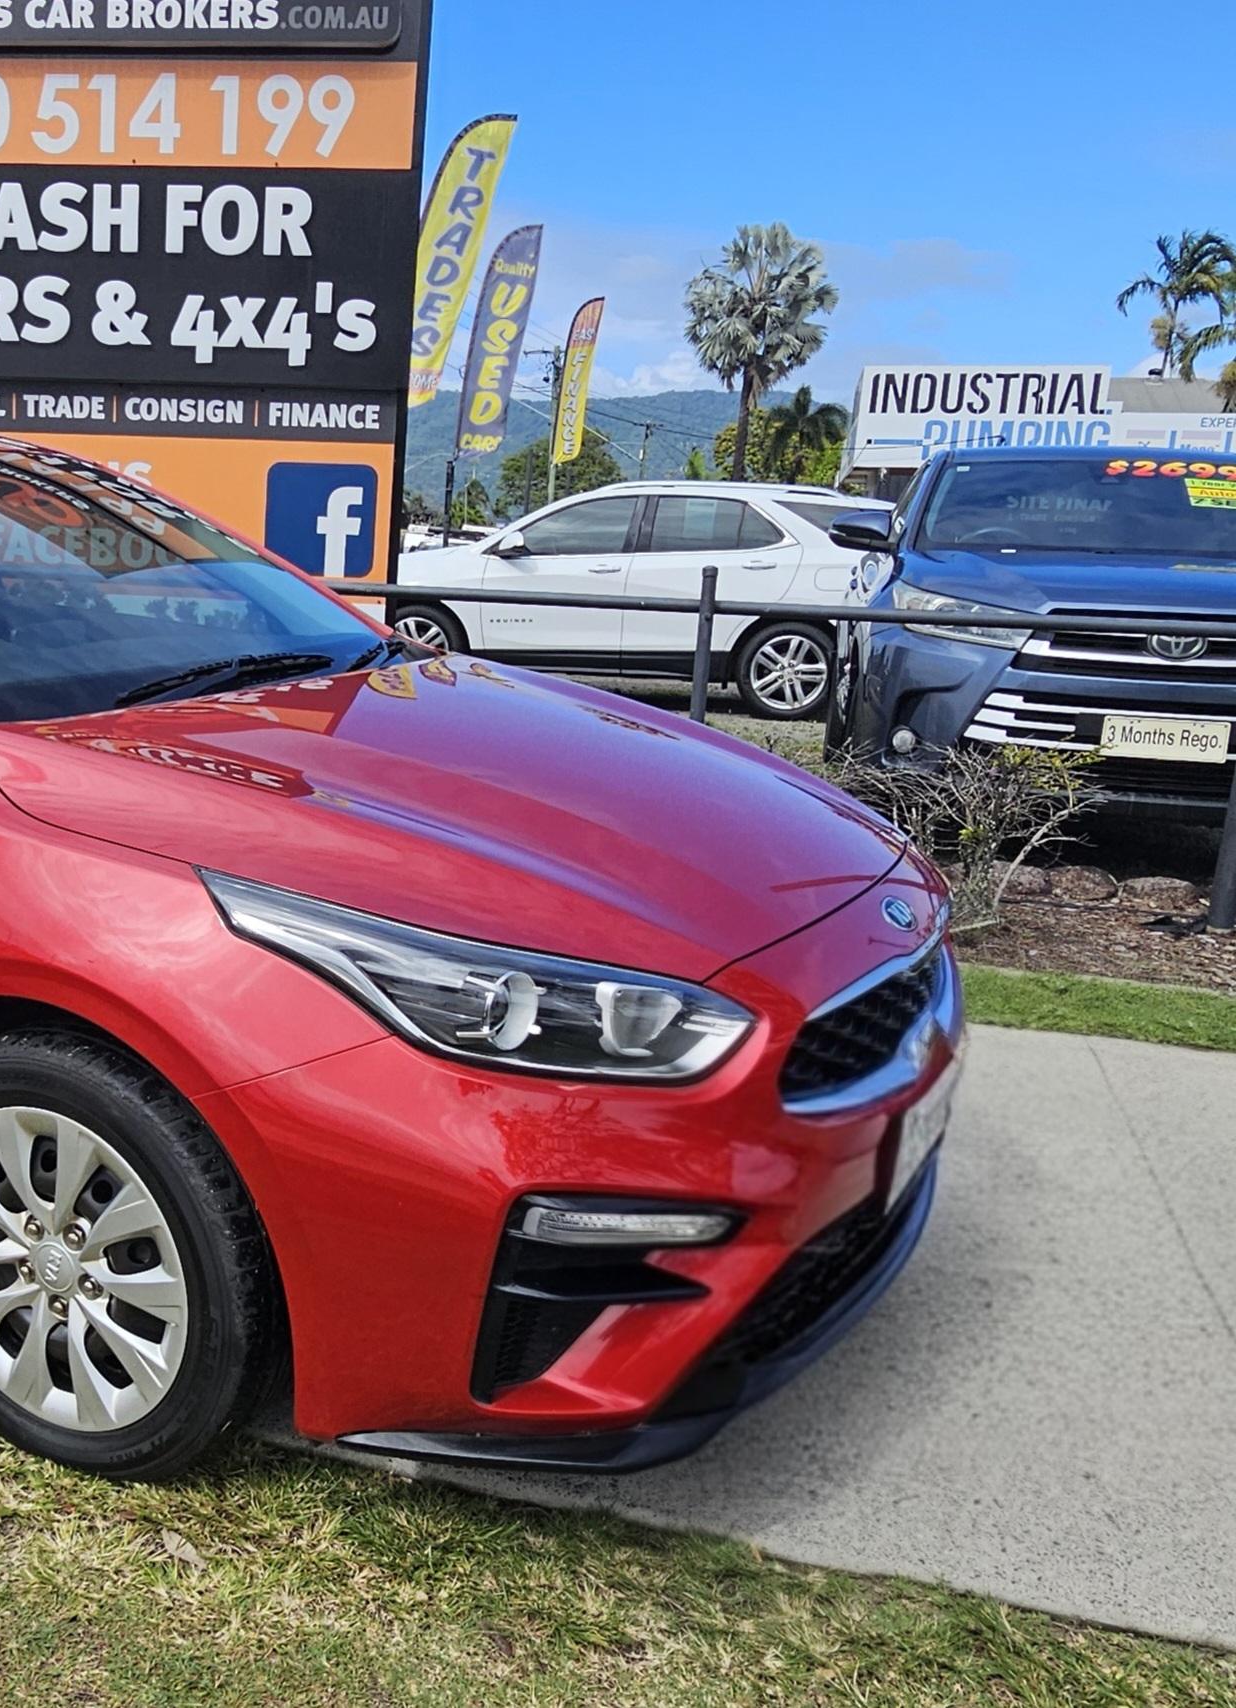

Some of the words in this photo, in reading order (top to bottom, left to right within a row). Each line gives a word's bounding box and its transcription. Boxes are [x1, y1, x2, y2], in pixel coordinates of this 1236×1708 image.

[24, 0, 95, 29] CAR
[31, 73, 181, 155] 514
[210, 74, 356, 158] 199
[165, 184, 313, 257] FOR
[412, 147, 496, 357] TRADES
[91, 279, 152, 346] &
[469, 281, 528, 425] USED
[572, 328, 596, 341] EAS
[22, 394, 106, 420] TRADE
[124, 397, 244, 424] CONSIGN
[268, 401, 381, 430] FINANCE
[562, 351, 587, 455] FINANCE
[868, 372, 1107, 414] INDUSTRIAL
[1200, 417, 1236, 428] EXPE
[107, 461, 153, 487] S
[316, 487, 363, 577] f
[1107, 725, 1116, 743] 3
[1120, 726, 1175, 745] Months
[1180, 730, 1222, 752] Rego.
[44, 1249, 63, 1281] KIA
